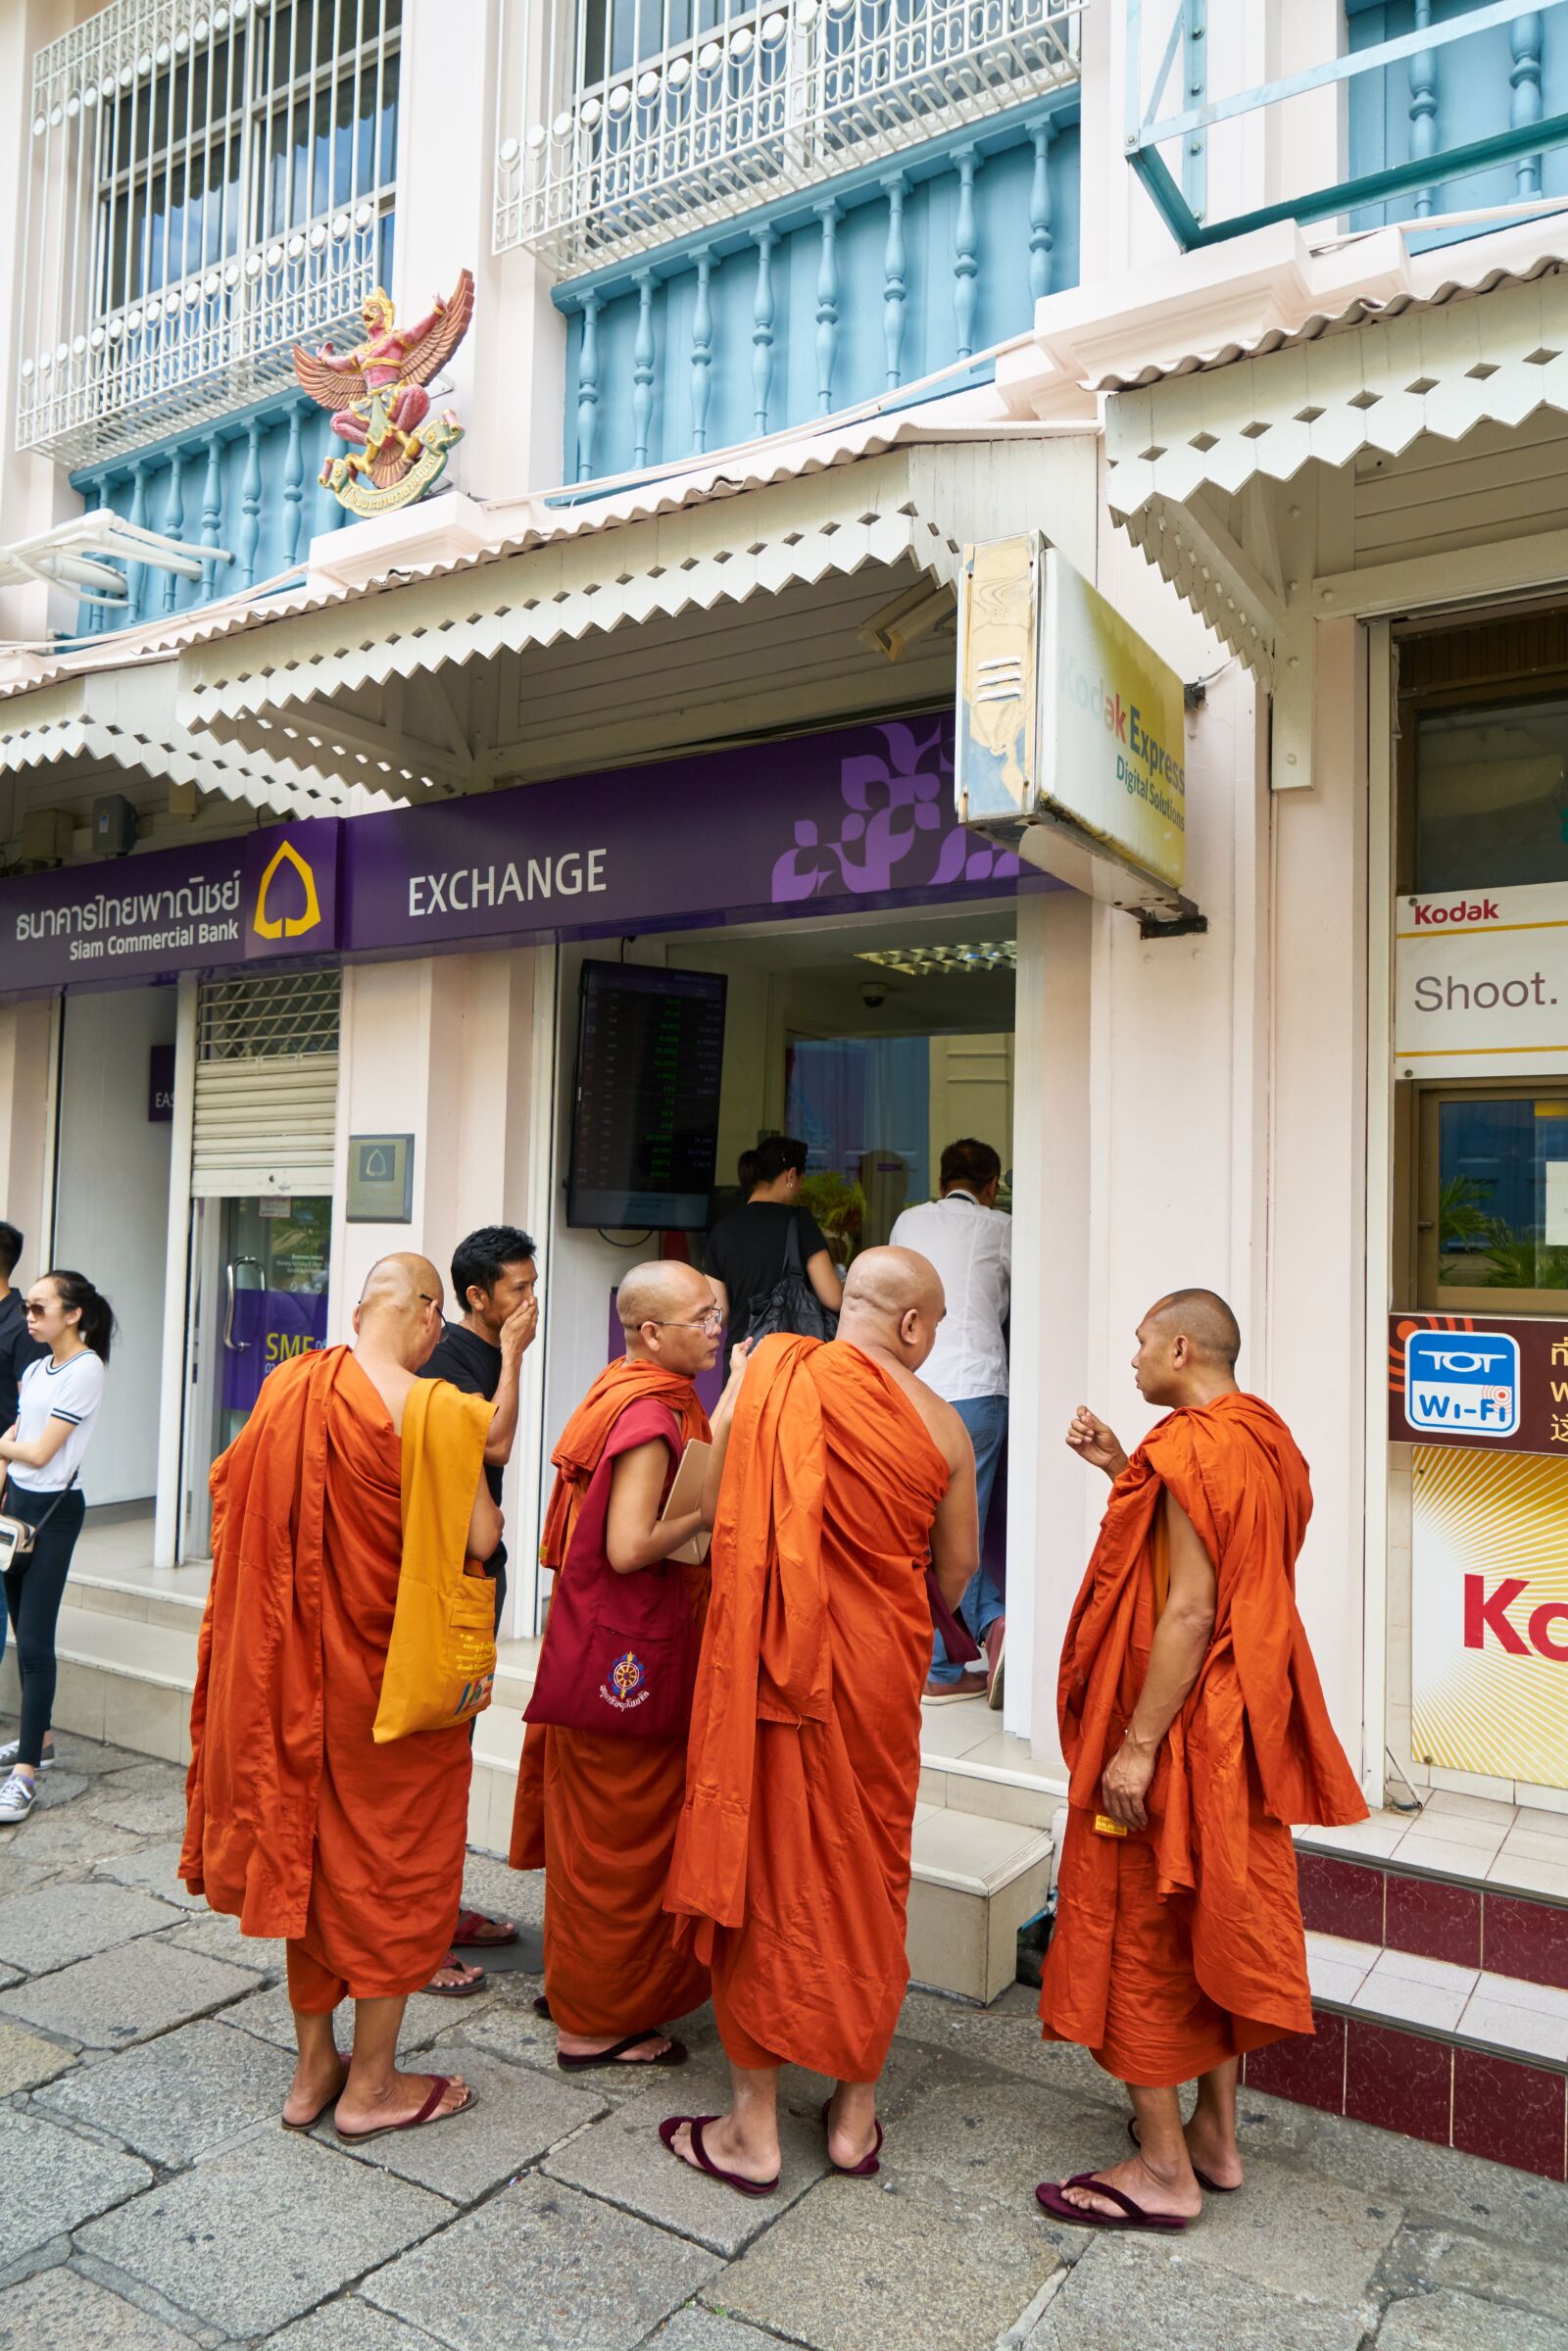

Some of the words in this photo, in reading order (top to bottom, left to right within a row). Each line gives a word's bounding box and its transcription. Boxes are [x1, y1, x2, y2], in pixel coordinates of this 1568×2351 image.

[1130, 705, 1185, 797] Express
[1116, 754, 1149, 801] Digital
[1150, 783, 1185, 832] Solutions
[409, 848, 607, 917] EXCHANGE
[16, 870, 241, 941] ธนาคารไทยพาณิชย์
[1414, 899, 1499, 925] Kodak
[70, 939, 104, 961] Siam
[107, 924, 194, 955] Commercial
[198, 918, 239, 944] Bank
[1414, 971, 1557, 1012] Shoot.
[1418, 1350, 1507, 1373] TOT
[1419, 1394, 1506, 1423] Wi-Fi
